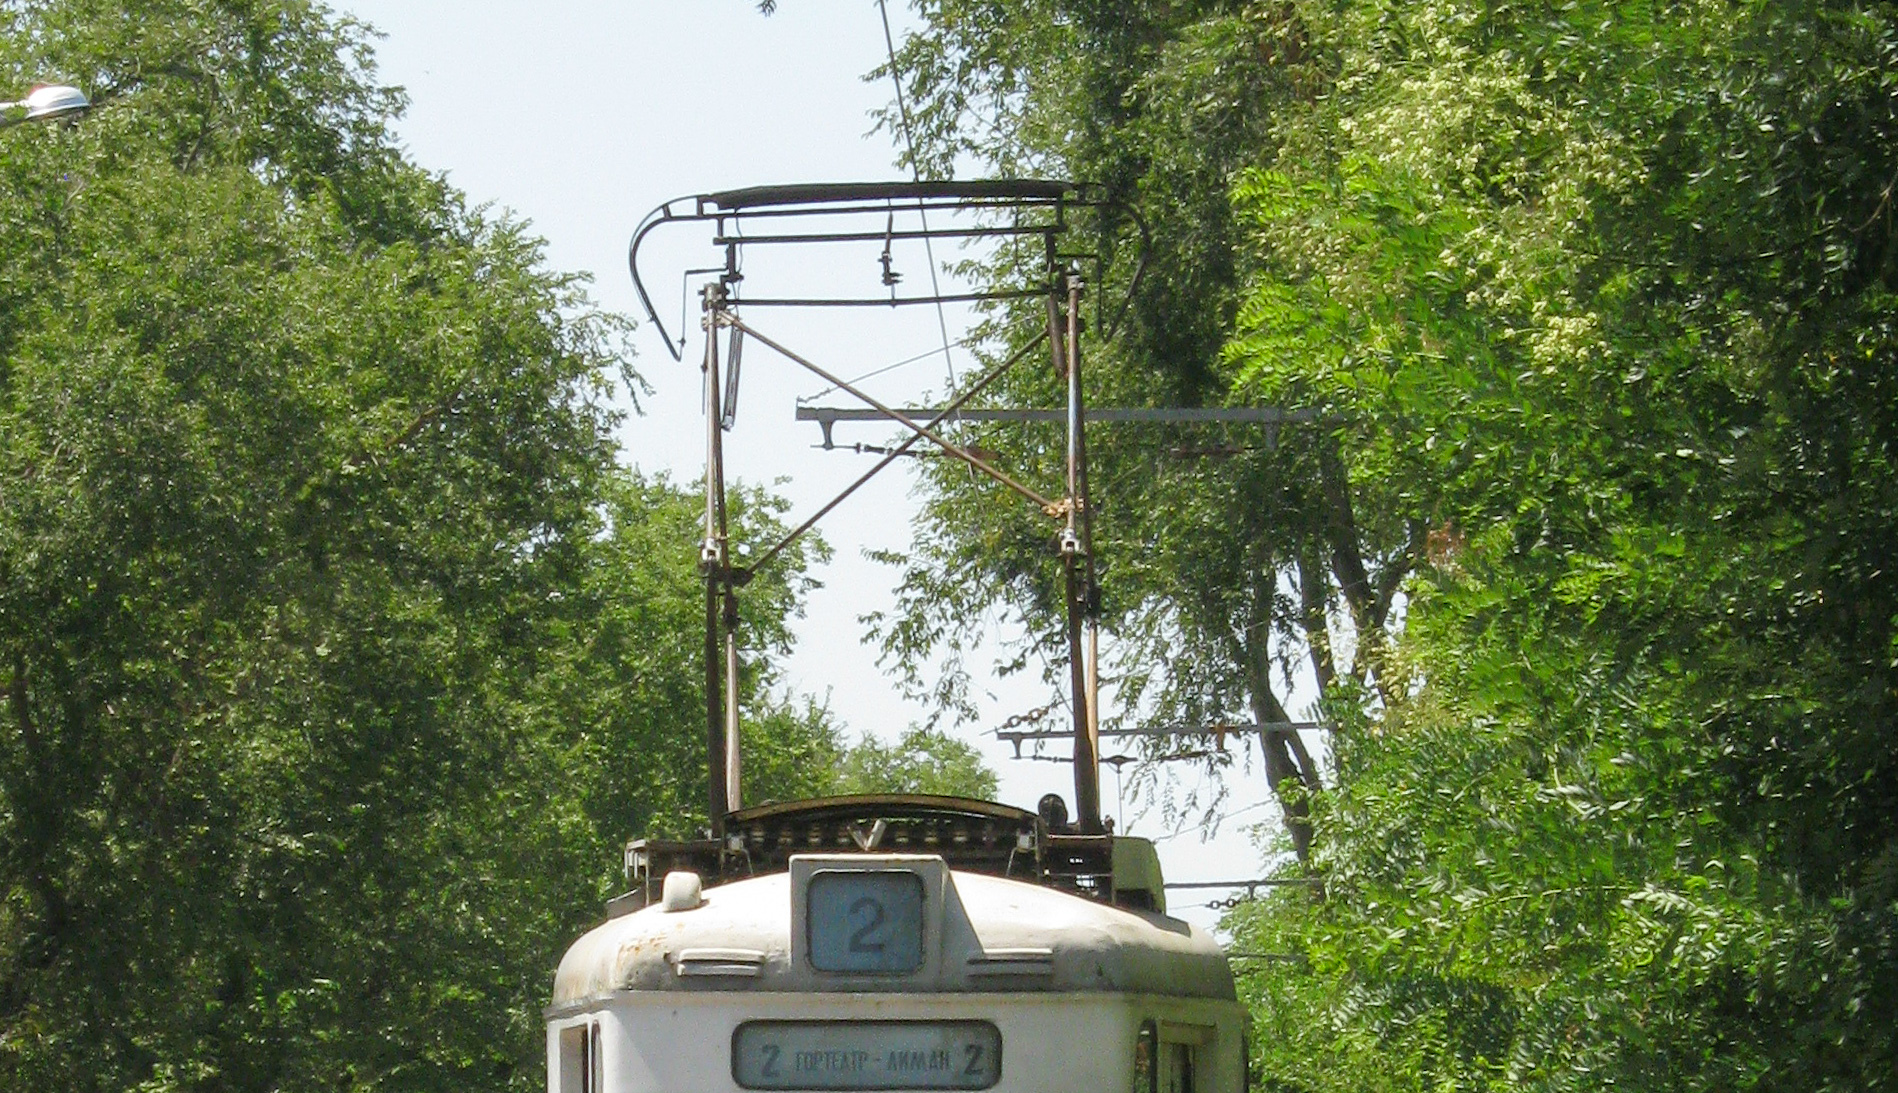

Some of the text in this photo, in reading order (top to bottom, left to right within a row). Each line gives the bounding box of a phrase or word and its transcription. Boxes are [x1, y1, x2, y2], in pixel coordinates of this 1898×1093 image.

[850, 896, 886, 953] 2
[759, 1044, 781, 1077] 2
[963, 1043, 985, 1076] 2
